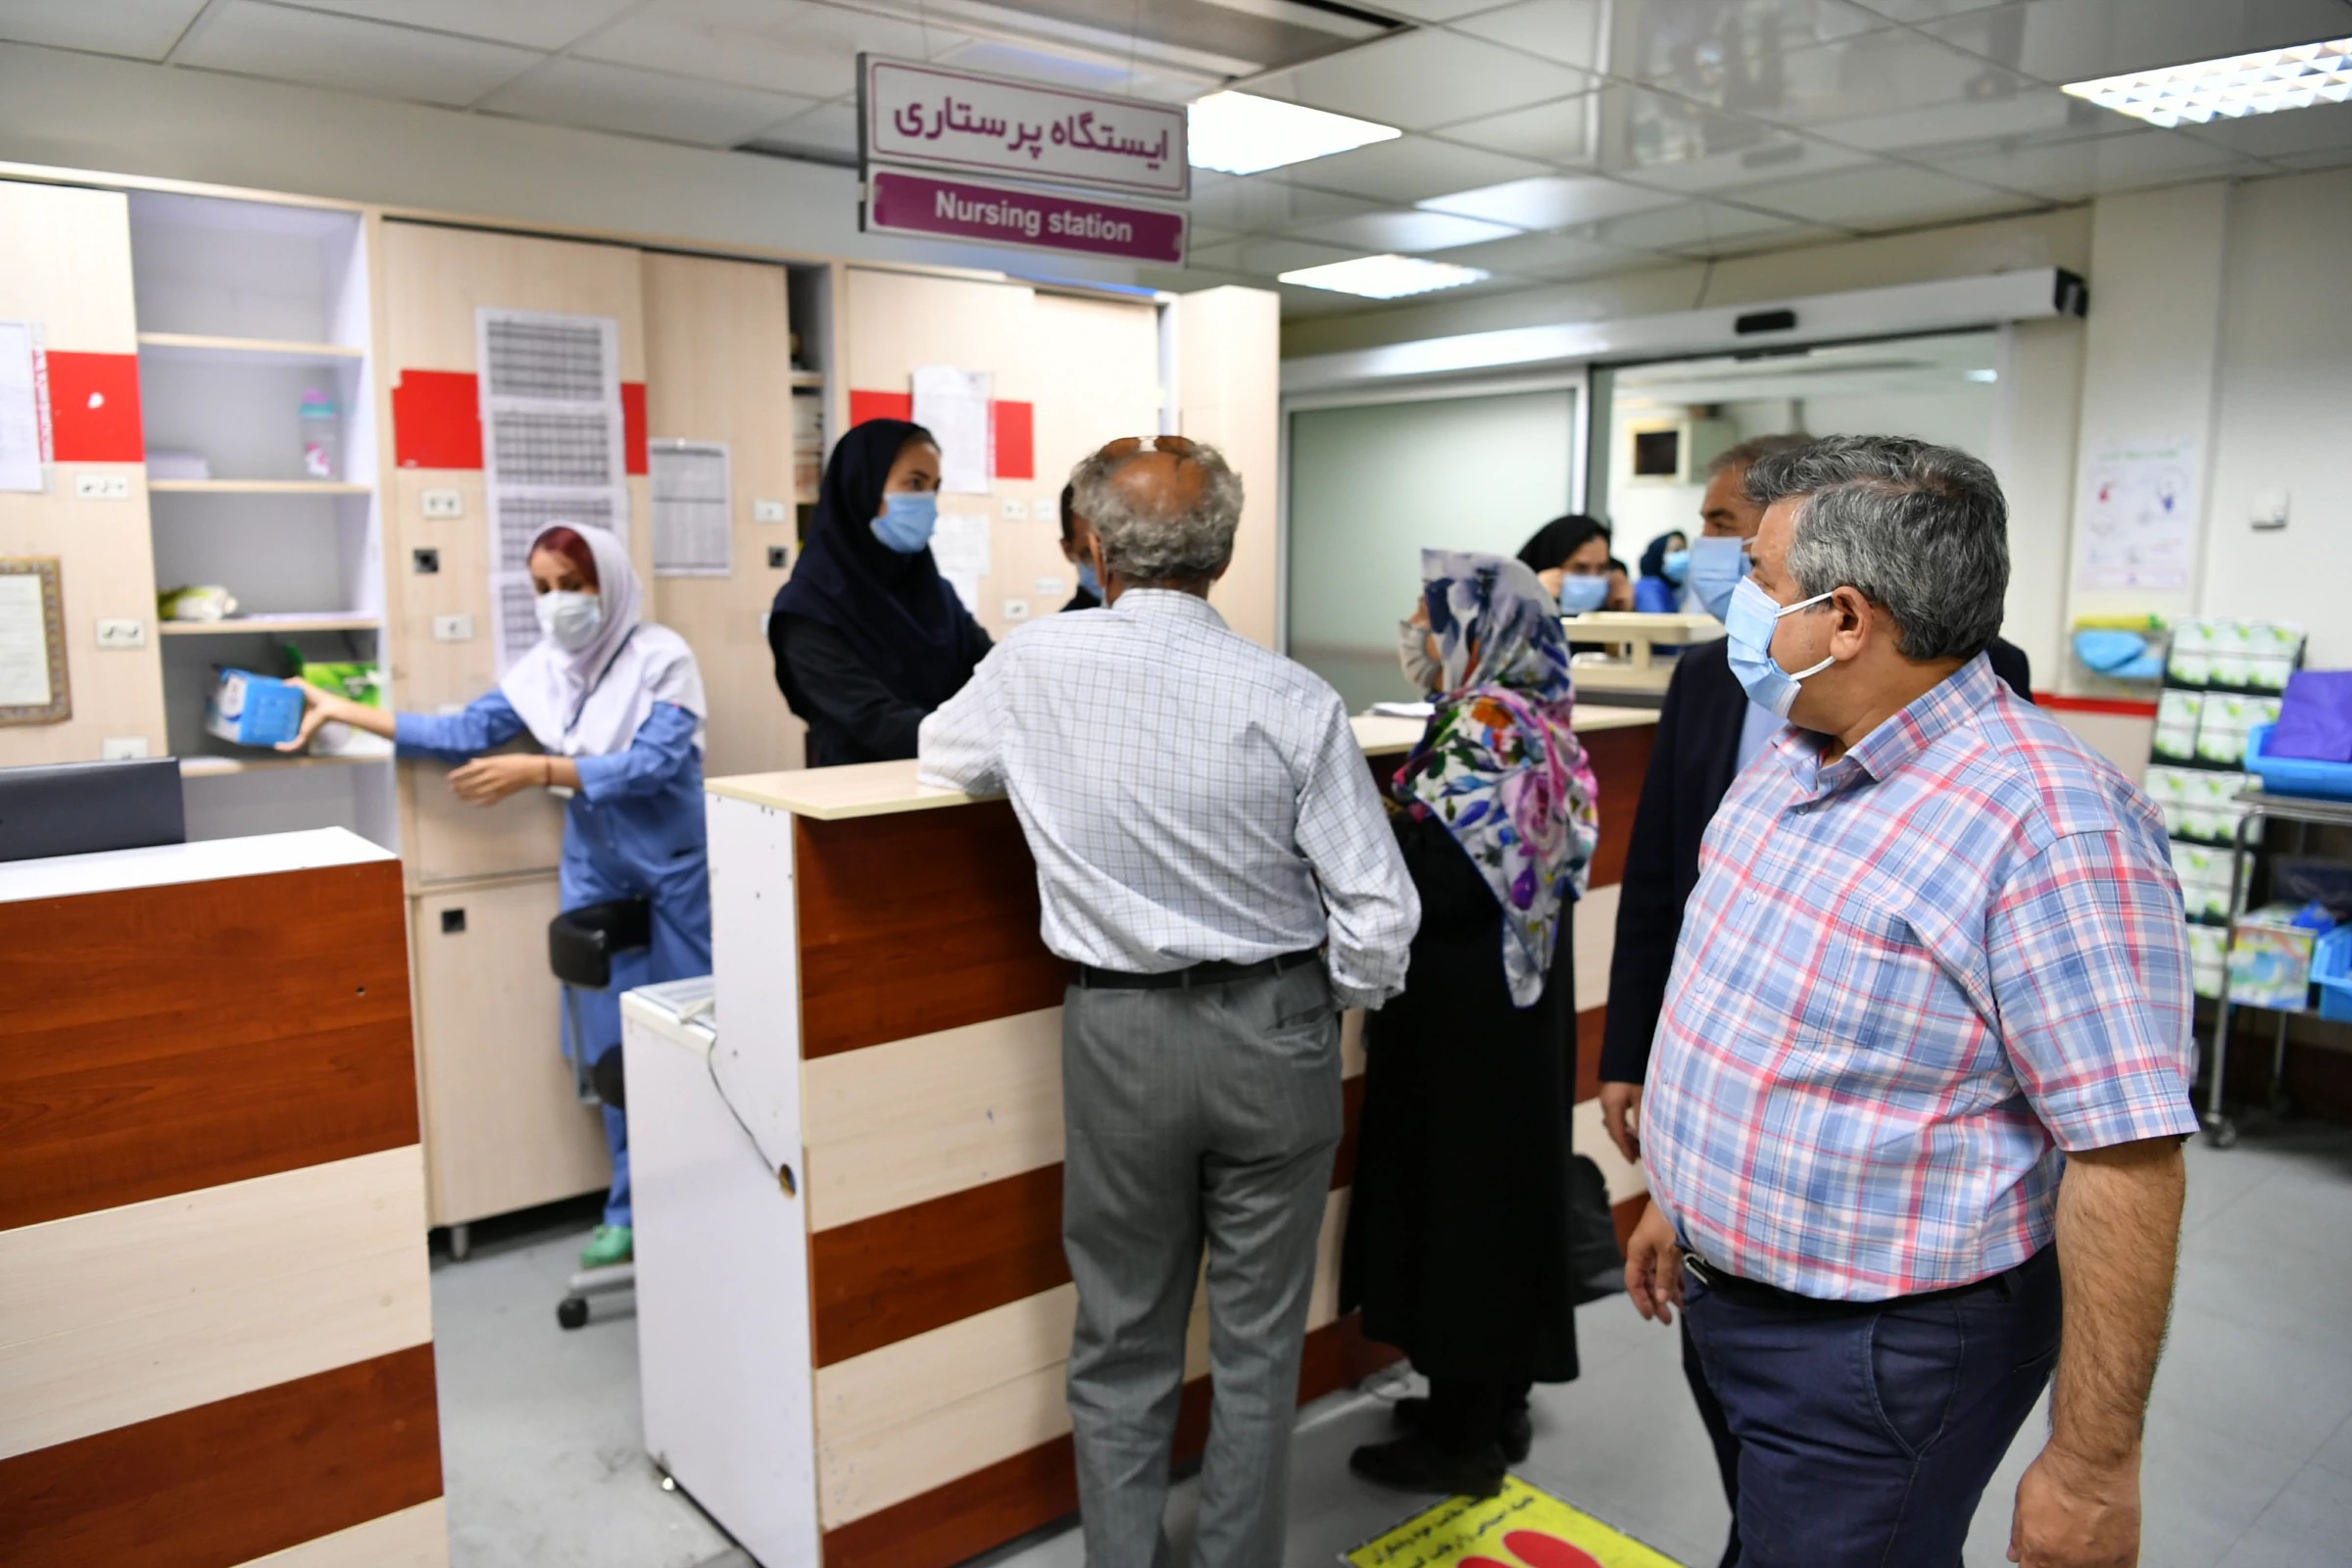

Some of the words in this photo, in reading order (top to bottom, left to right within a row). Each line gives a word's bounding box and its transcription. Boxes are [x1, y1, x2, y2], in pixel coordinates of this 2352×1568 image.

[894, 97, 1043, 159] پرستاری
[1051, 112, 1168, 170] ایستگاه
[935, 190, 1041, 236] Nursing
[1048, 210, 1132, 242] station
